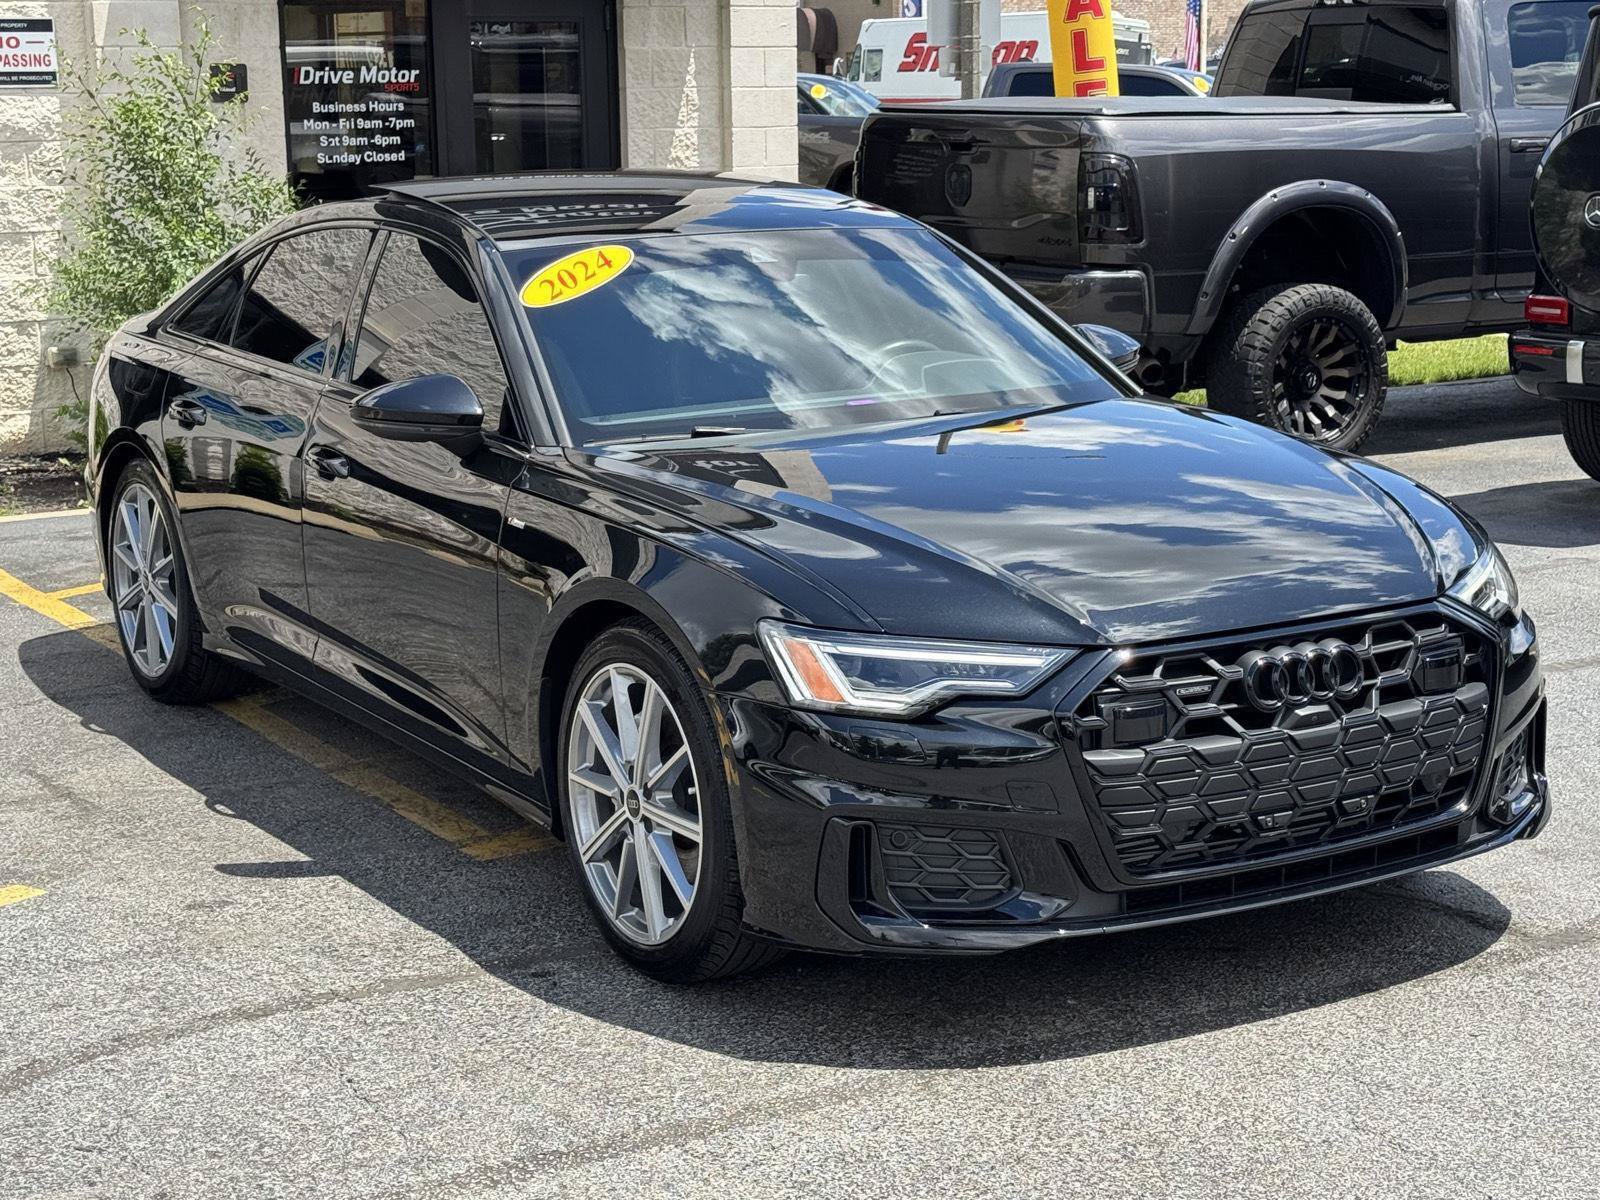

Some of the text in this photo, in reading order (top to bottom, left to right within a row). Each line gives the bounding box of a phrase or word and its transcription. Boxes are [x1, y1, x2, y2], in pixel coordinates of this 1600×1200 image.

[0, 36, 20, 49] O
[360, 66, 419, 84] Motor
[384, 83, 419, 92] SPORTS
[312, 101, 404, 113] Business Hours
[303, 119, 329, 130] Mon
[357, 118, 382, 129] 9am
[342, 136, 368, 146] 9am
[364, 151, 405, 162] Closed
[539, 250, 612, 301] 2024
